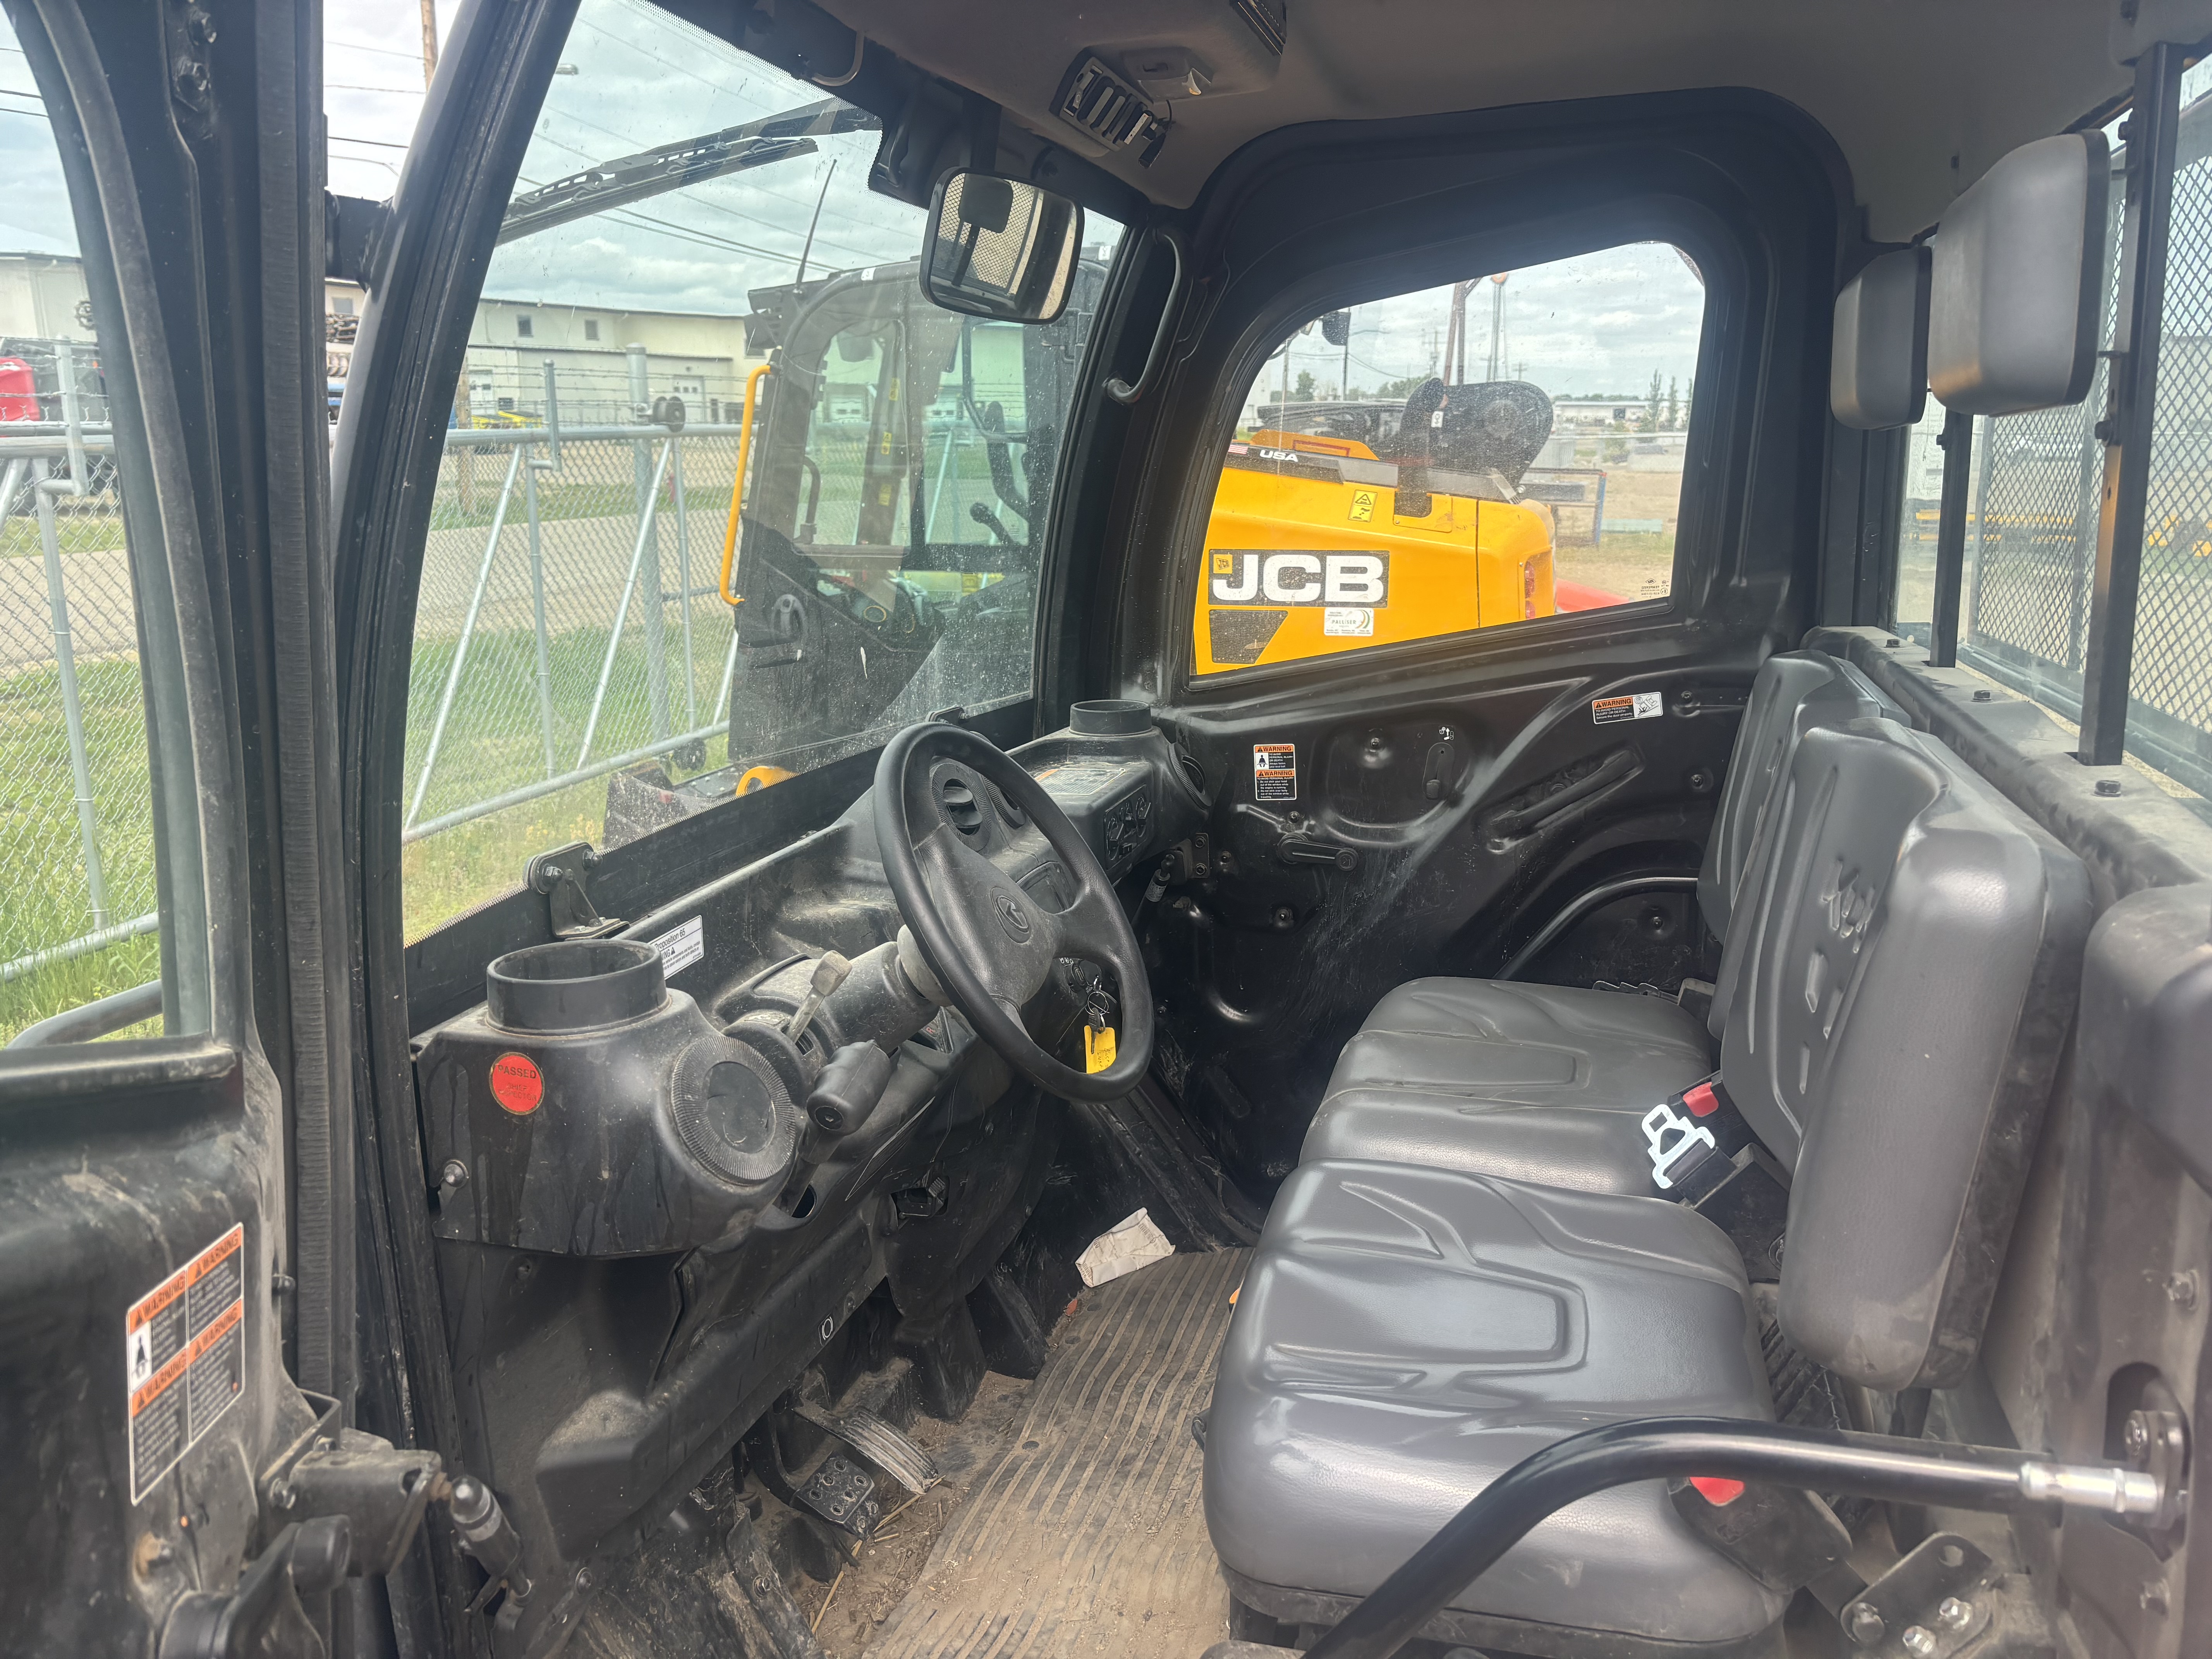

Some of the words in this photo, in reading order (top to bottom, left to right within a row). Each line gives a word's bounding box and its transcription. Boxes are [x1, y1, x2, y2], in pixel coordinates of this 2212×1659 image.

[1260, 450, 1298, 462] USA
[1212, 555, 1384, 603] JCB
[1602, 699, 1631, 707] WARNING
[680, 928, 685, 938] 65
[498, 1065, 536, 1079] PASSED
[202, 1233, 239, 1271] WARNING
[145, 1276, 184, 1317] WARNING
[203, 1307, 238, 1346] WARNING
[146, 1354, 186, 1398] WARNING
